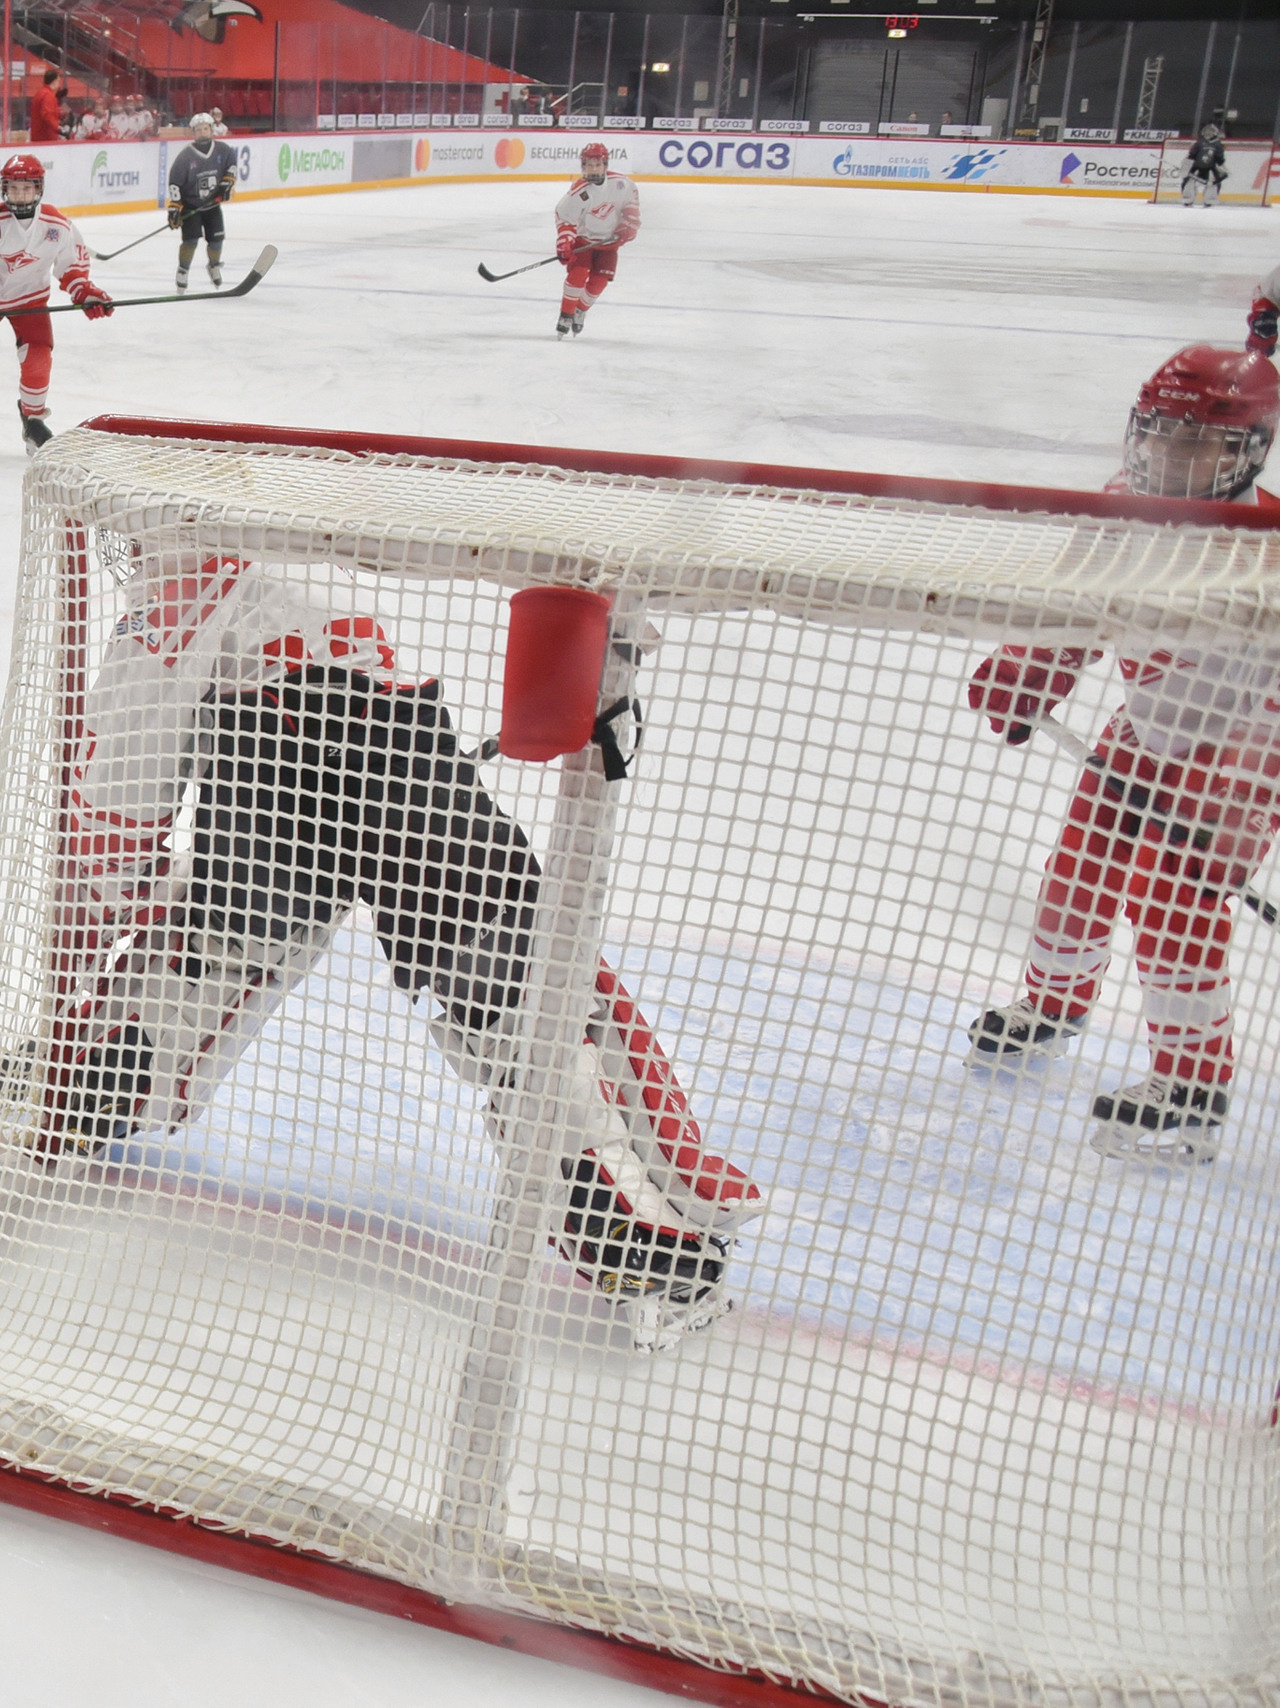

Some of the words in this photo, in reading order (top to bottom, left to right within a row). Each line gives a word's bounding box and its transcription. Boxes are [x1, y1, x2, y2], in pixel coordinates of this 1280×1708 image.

[1070, 129, 1111, 139] KHL.RU
[432, 144, 484, 160] mastercard
[530, 146, 582, 161] БЕСЦЕНН
[1084, 162, 1182, 178] Ростелеко
[1158, 388, 1201, 402] CCM
